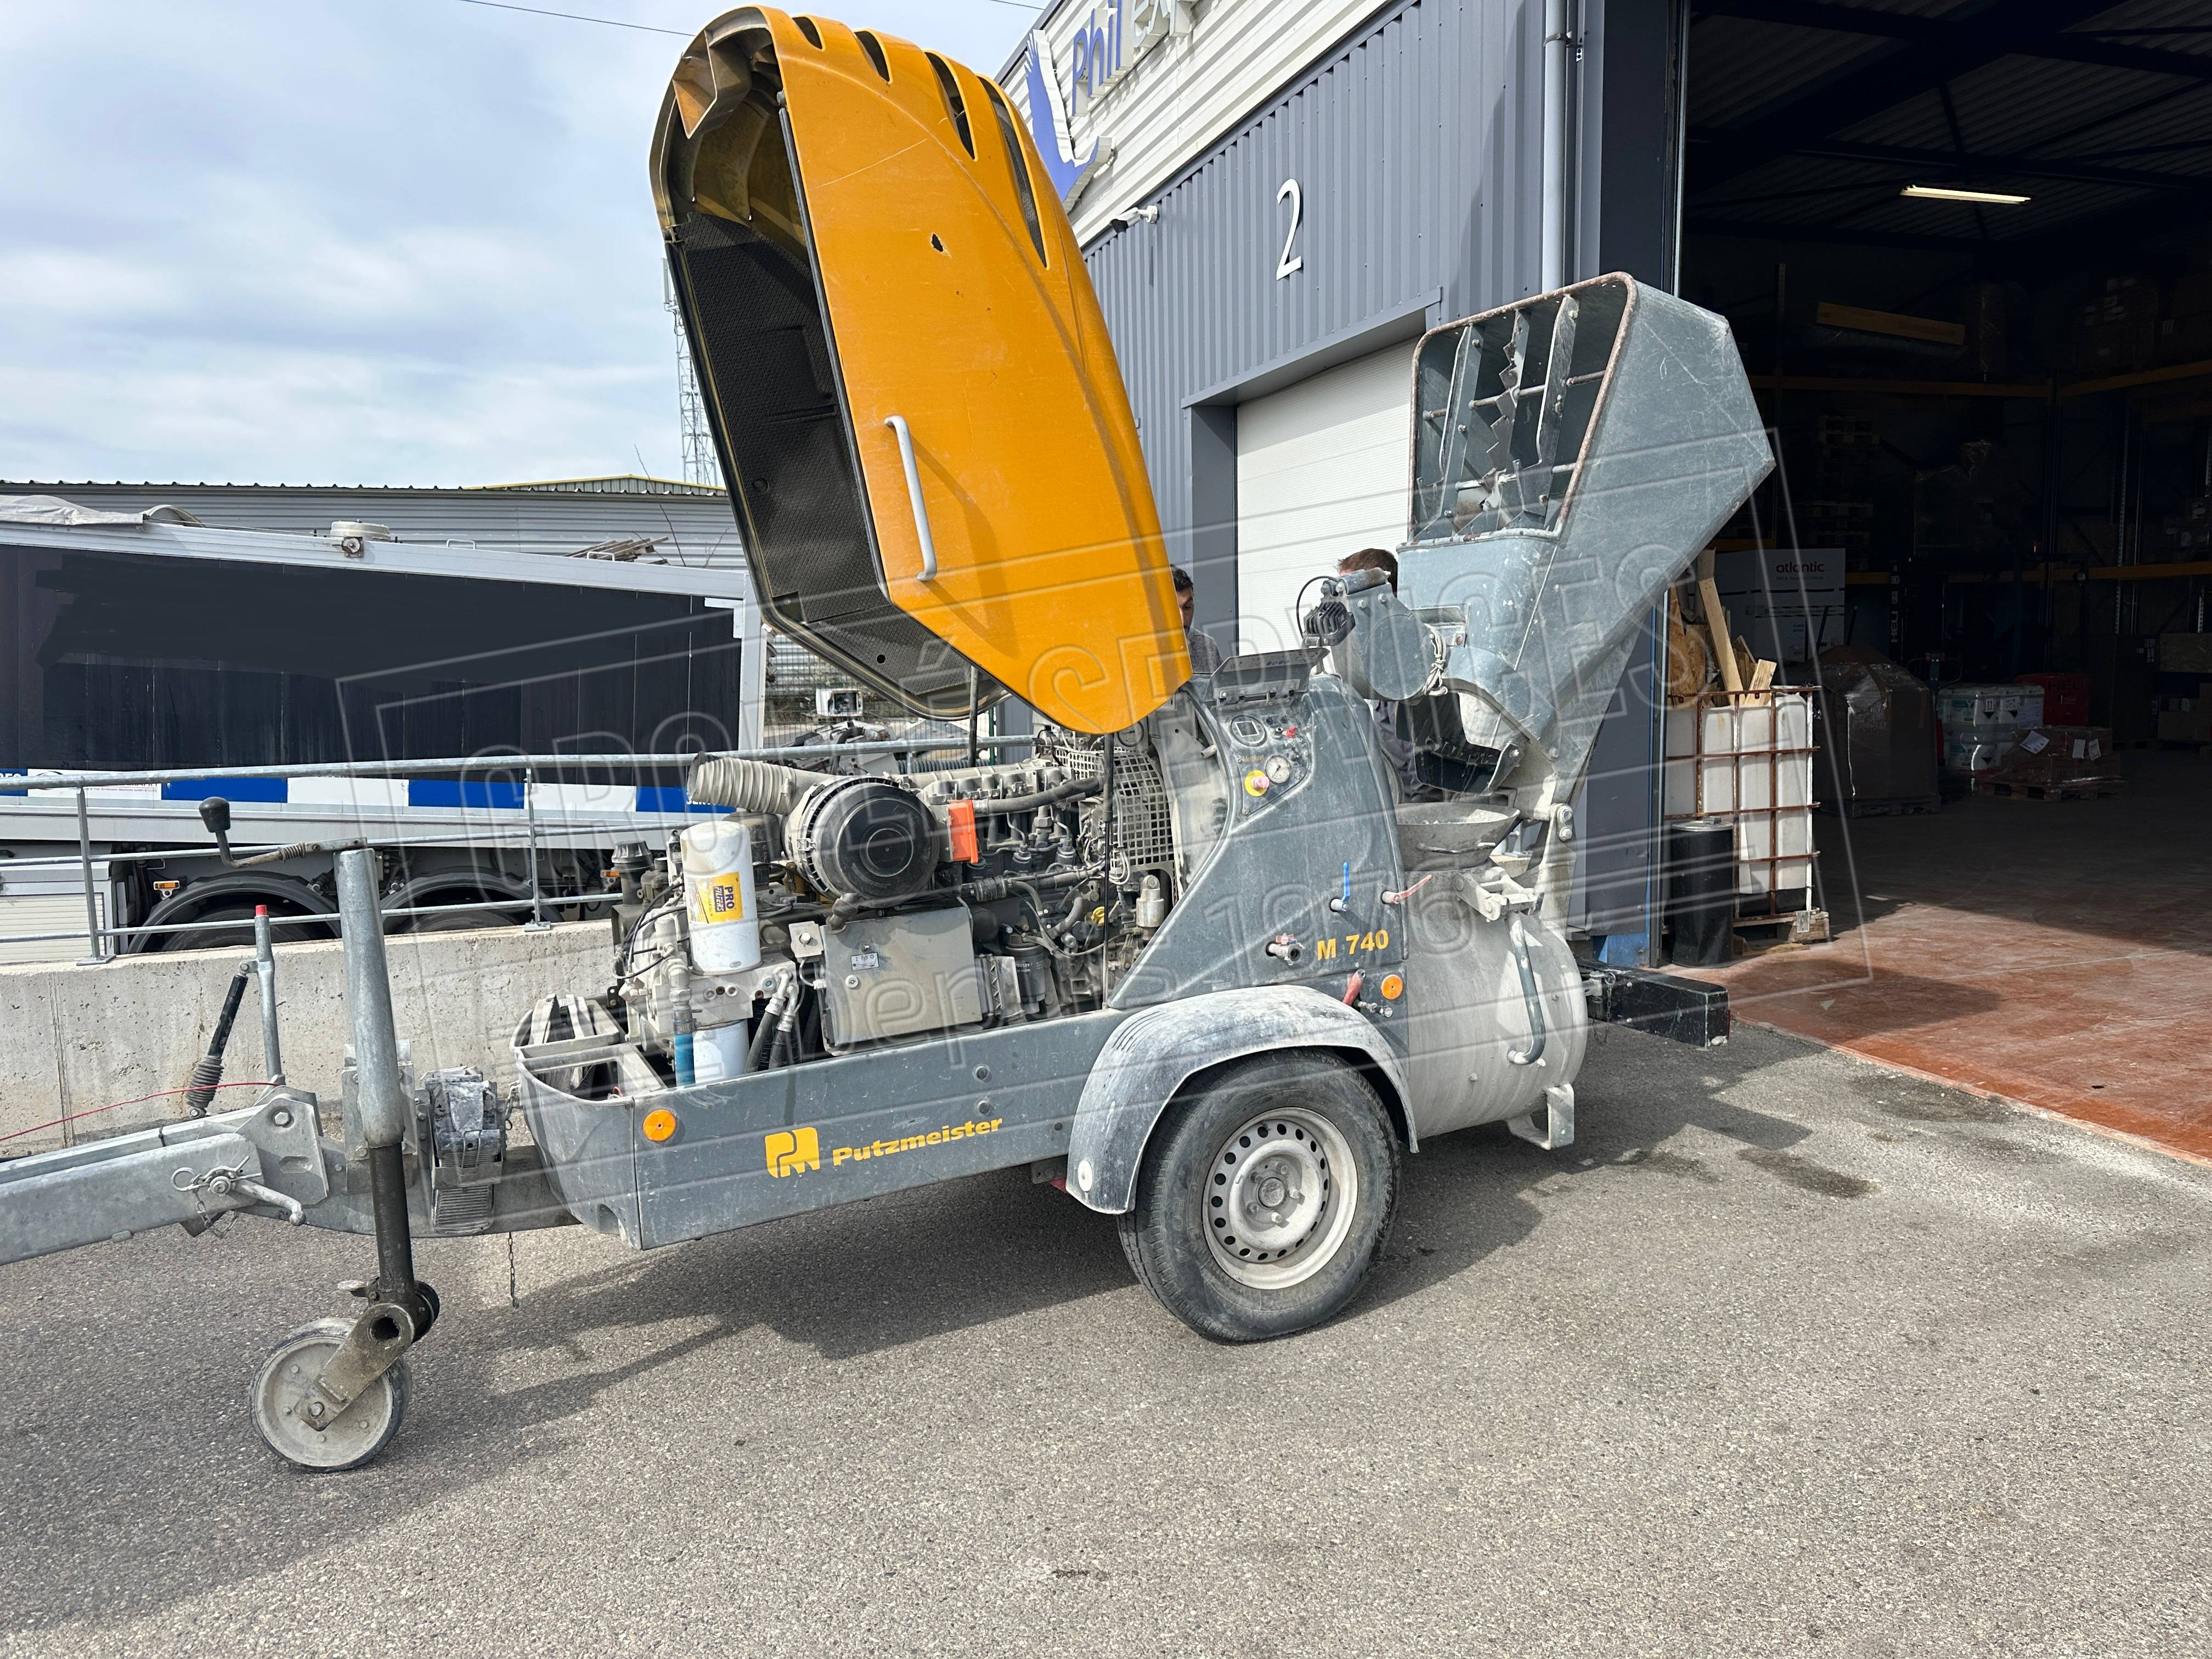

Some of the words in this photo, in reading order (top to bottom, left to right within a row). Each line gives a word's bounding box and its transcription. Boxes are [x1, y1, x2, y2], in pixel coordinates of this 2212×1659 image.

[1276, 178, 1302, 281] 2
[1776, 561, 1824, 573] atlantic
[714, 886, 725, 912] FILTERS
[724, 886, 735, 909] PRO
[1317, 938, 1336, 961] M
[1345, 929, 1389, 955] 740
[832, 1118, 1003, 1166] Putzmeister
